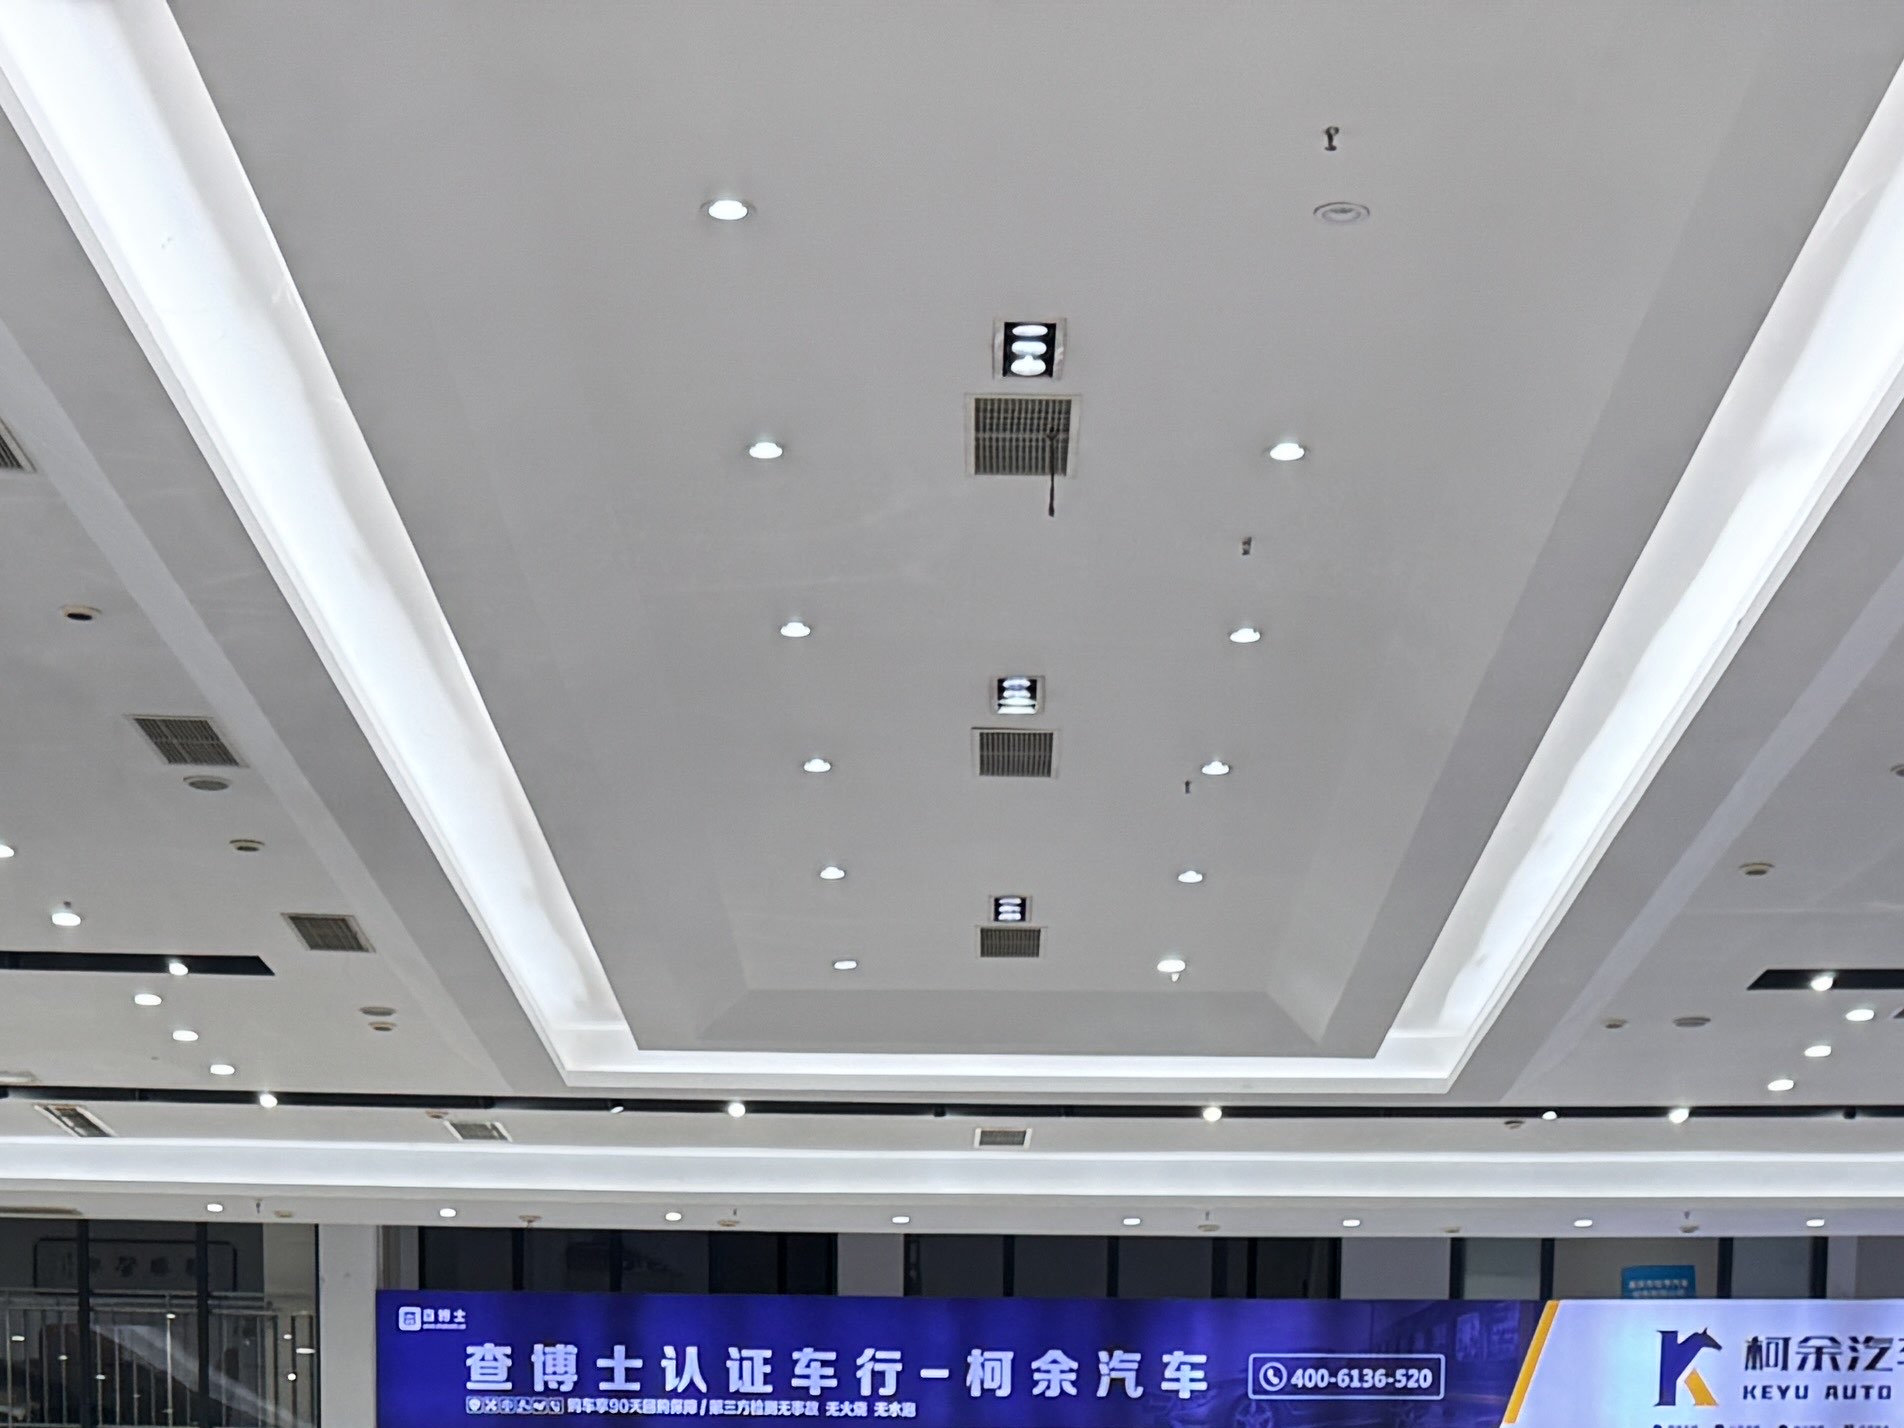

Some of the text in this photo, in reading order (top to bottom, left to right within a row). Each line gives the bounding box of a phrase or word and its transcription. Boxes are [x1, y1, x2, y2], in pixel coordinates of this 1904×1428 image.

[1290, 1368, 1433, 1388] 400-6136-520
[1743, 1384, 1892, 1400] KEYU AUTO
